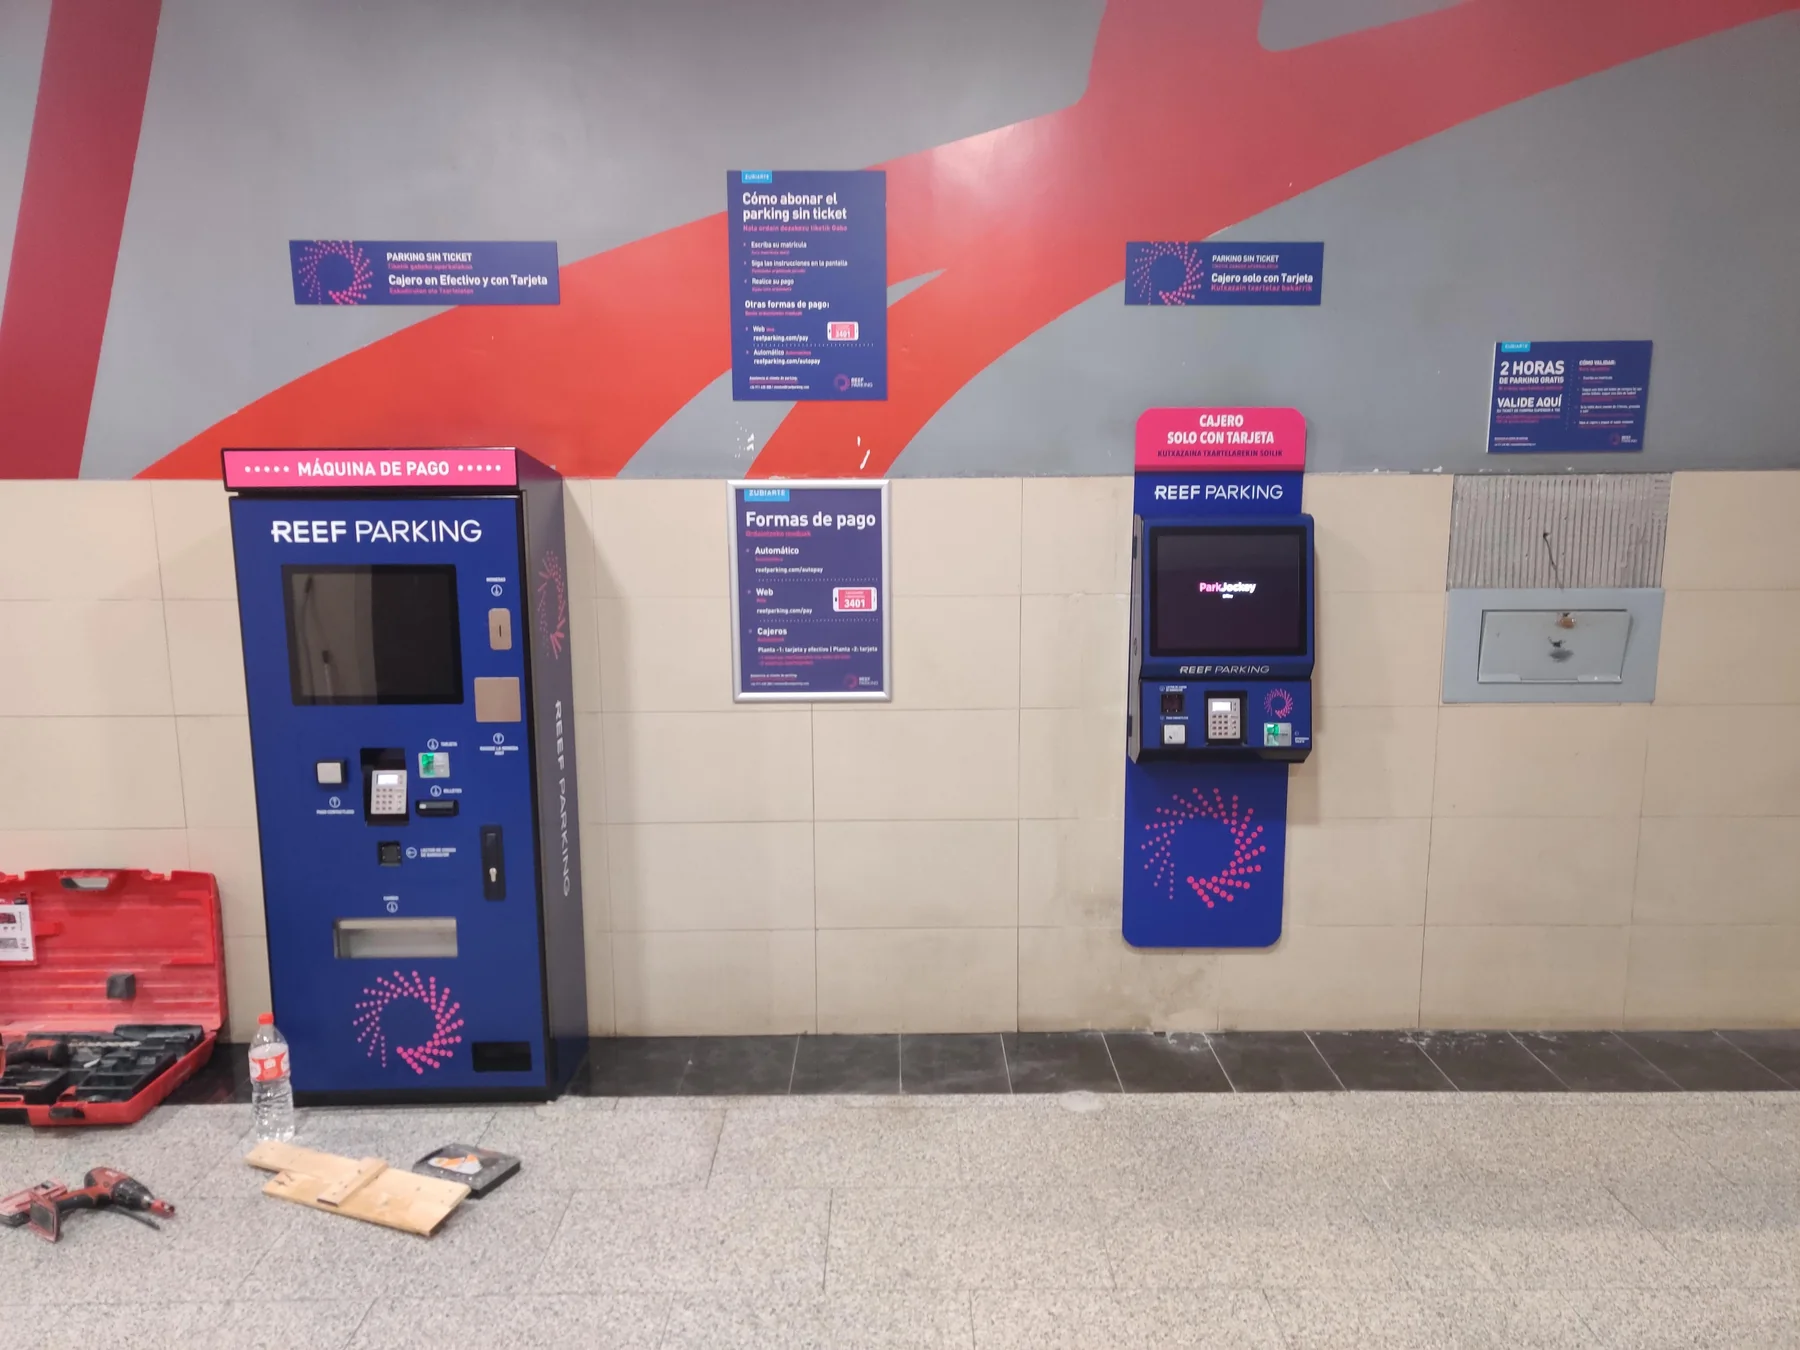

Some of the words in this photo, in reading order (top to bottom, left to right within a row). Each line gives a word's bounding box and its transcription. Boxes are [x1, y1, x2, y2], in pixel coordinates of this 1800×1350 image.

[743, 191, 777, 206] Cómo
[780, 192, 823, 206] abonar
[826, 192, 838, 206] el
[743, 207, 790, 222] parking
[792, 207, 811, 220] sin
[813, 207, 847, 220] ticket
[751, 241, 772, 249] Escriba
[386, 252, 426, 262] PARKING
[426, 252, 441, 262] SIN
[442, 252, 472, 262] TICKET
[1212, 255, 1242, 263] PARKING
[1242, 255, 1255, 263] SIN
[1256, 255, 1279, 263] TICKET
[751, 260, 763, 268] Siga
[825, 260, 848, 268] pantalla
[388, 274, 423, 288] Cajero
[424, 276, 438, 286] en
[440, 274, 481, 286] Efectivo
[482, 277, 489, 288] y
[490, 276, 509, 286] con
[510, 274, 548, 288] Tarjeta
[1211, 273, 1241, 285] Cajero
[1242, 273, 1262, 283] solo
[1263, 275, 1280, 283] con
[1281, 273, 1313, 285] Tarjeta
[745, 300, 766, 309] Otras
[767, 300, 795, 309] formas
[797, 300, 807, 309] de
[808, 300, 830, 310] pago:
[753, 325, 766, 333] Web
[1500, 361, 1510, 376] 2
[1512, 360, 1565, 376] HORAS
[1499, 377, 1509, 385] DE
[1540, 376, 1565, 384] GRATIS
[1497, 397, 1535, 408] VALIDE
[1536, 394, 1563, 408] AQUÍ
[1200, 414, 1244, 428] CAJERO
[1167, 431, 1197, 445] SOLO
[1200, 431, 1225, 444] CON
[1227, 431, 1275, 445] TARJETA
[297, 458, 377, 477] MÁQUINA
[380, 461, 403, 477] DE
[406, 460, 450, 477] PAGO
[748, 489, 786, 497] ZUBIARTE
[1154, 485, 1201, 500] REEF
[1205, 485, 1284, 500] PARKING
[746, 511, 809, 528] Formas
[812, 511, 833, 527] de
[837, 513, 876, 530] pago
[271, 520, 347, 544] REEF
[355, 519, 483, 543] PARKING
[754, 545, 800, 555] Automático
[756, 588, 774, 597] Web
[1199, 581, 1257, 594] ParkJockey
[844, 598, 866, 609] 3401
[757, 627, 788, 636] Cajeros
[785, 646, 803, 654] tarjeta
[859, 646, 878, 654] tarjeta
[1179, 665, 1213, 674] REEF
[1214, 665, 1270, 674] PARKING
[555, 700, 565, 770] REEF
[559, 777, 571, 896] PARKING
